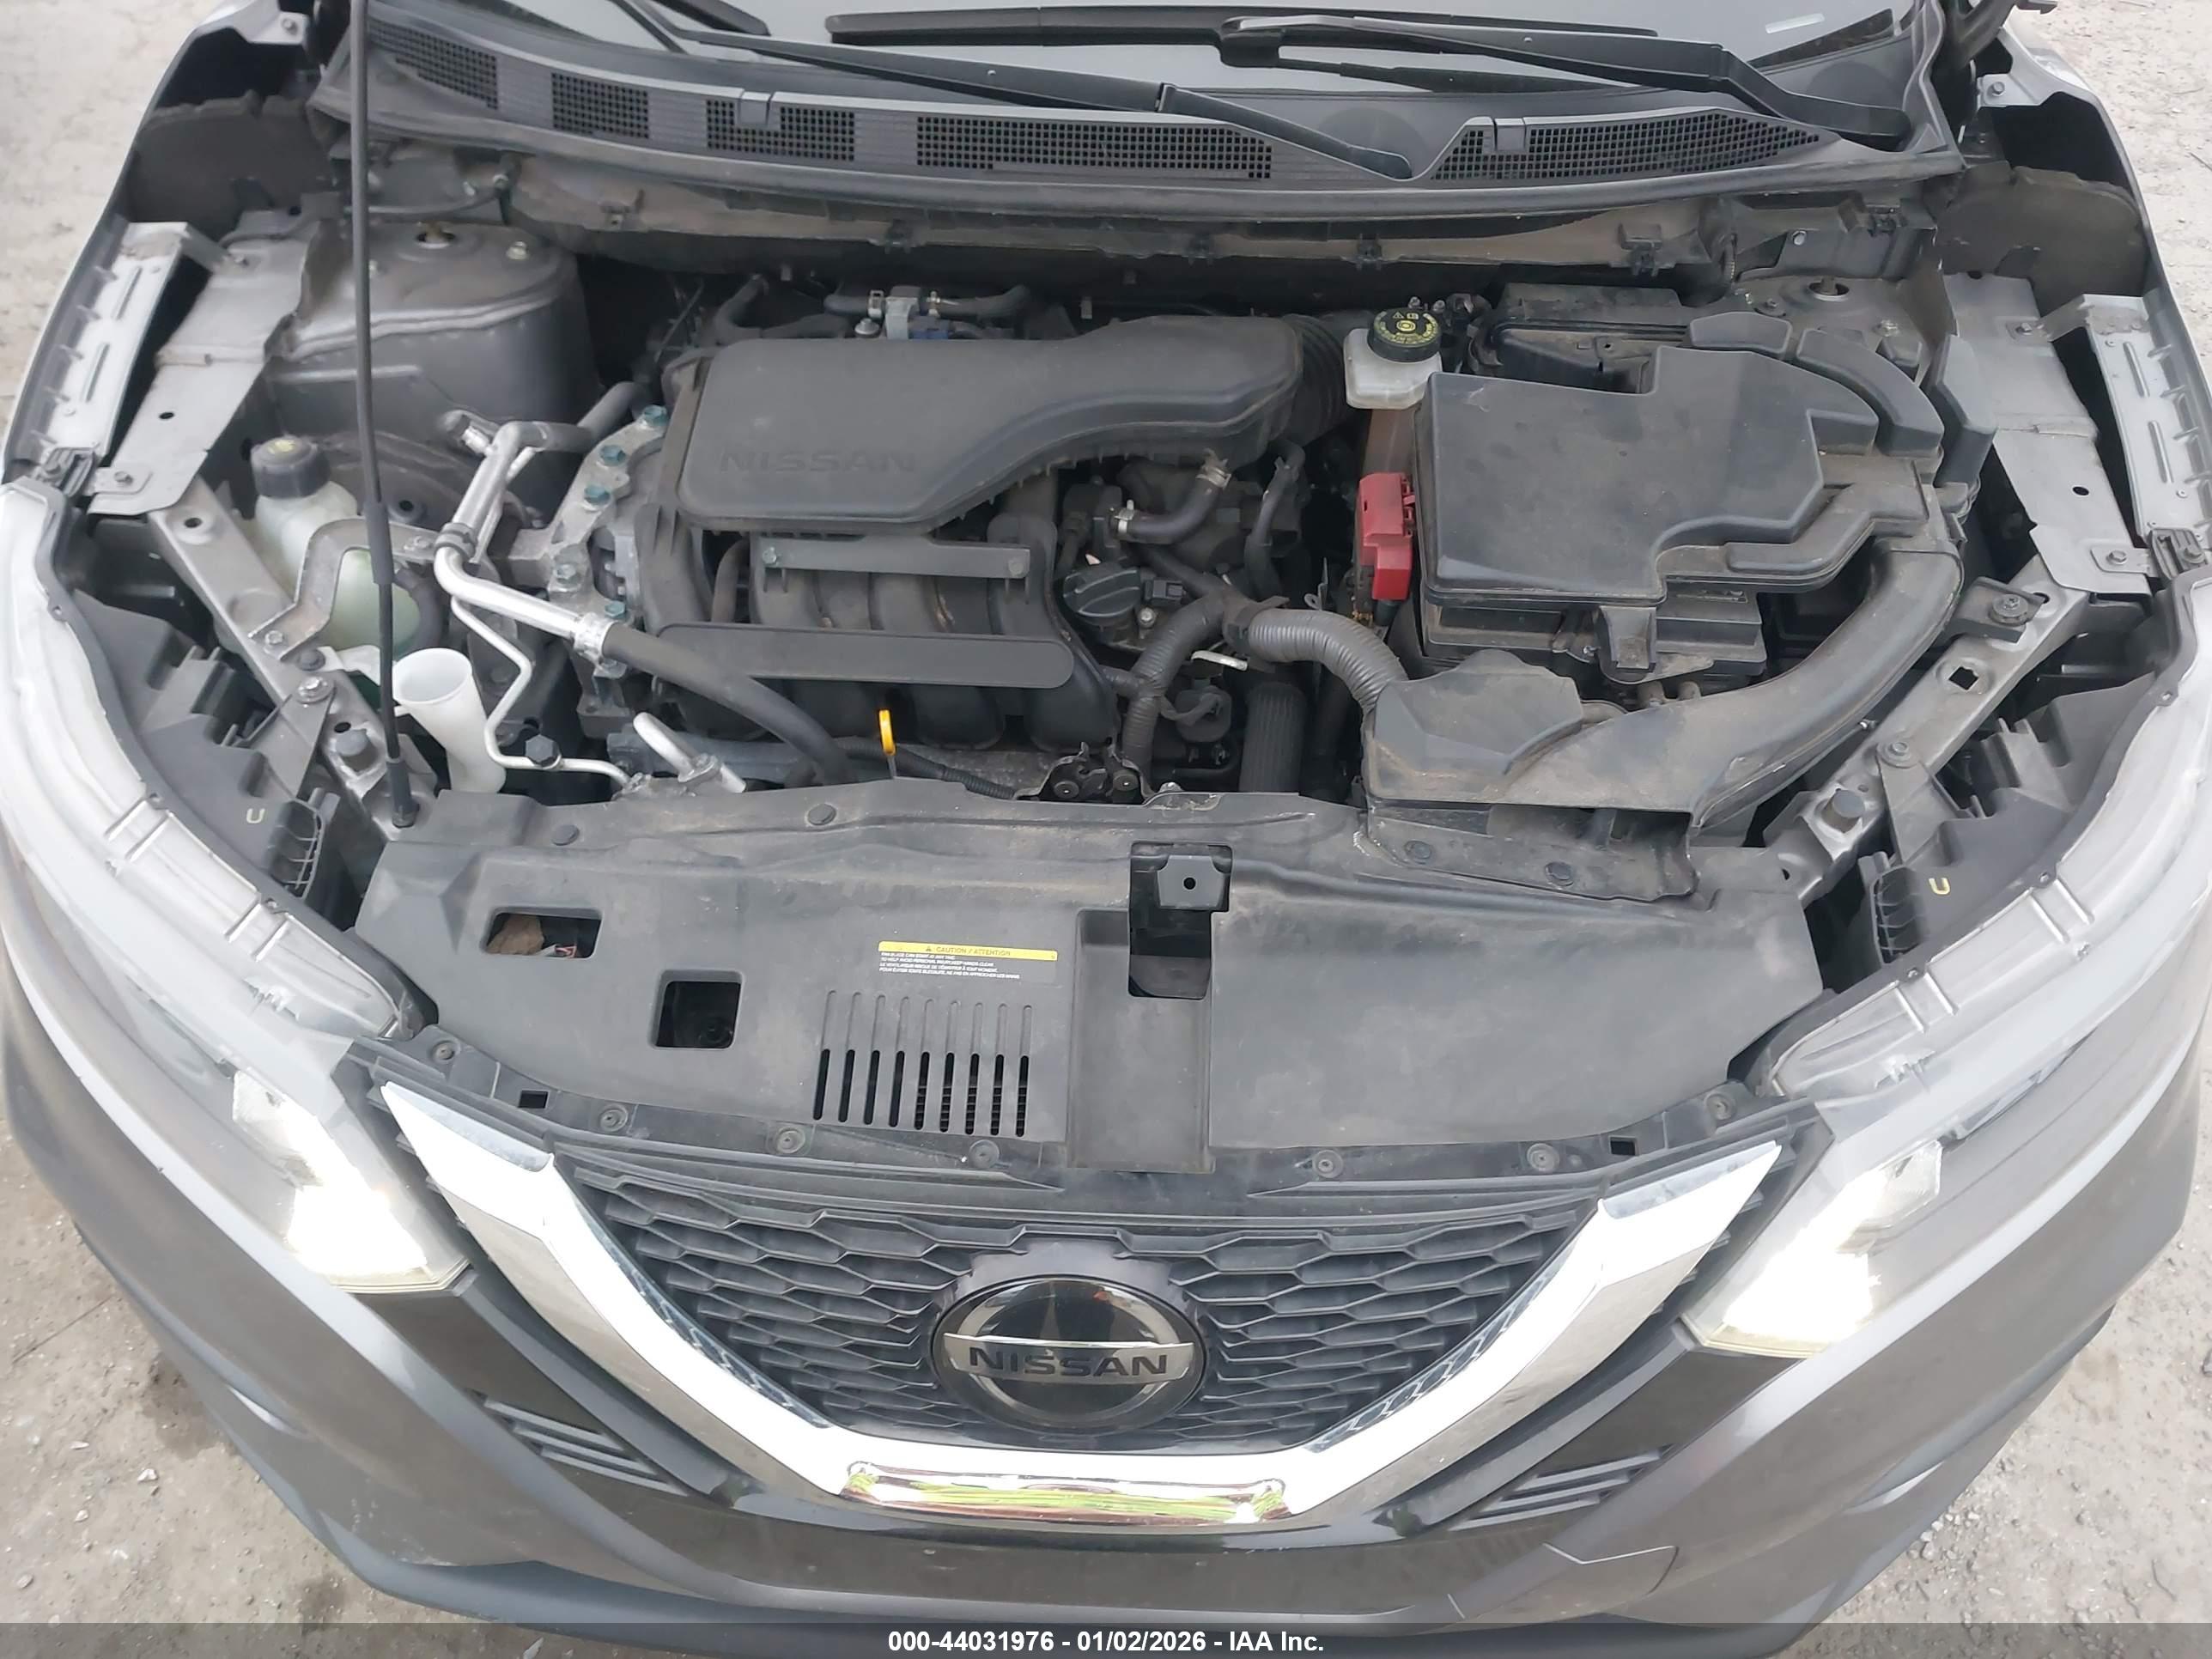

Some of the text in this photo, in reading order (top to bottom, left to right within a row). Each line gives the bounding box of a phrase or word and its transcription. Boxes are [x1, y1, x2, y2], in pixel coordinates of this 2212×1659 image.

[720, 452, 917, 472] NISSAN
[935, 945, 967, 954] CAUTION
[973, 948, 1012, 957] ATTENTION
[969, 1347, 1168, 1376] NISSAN
